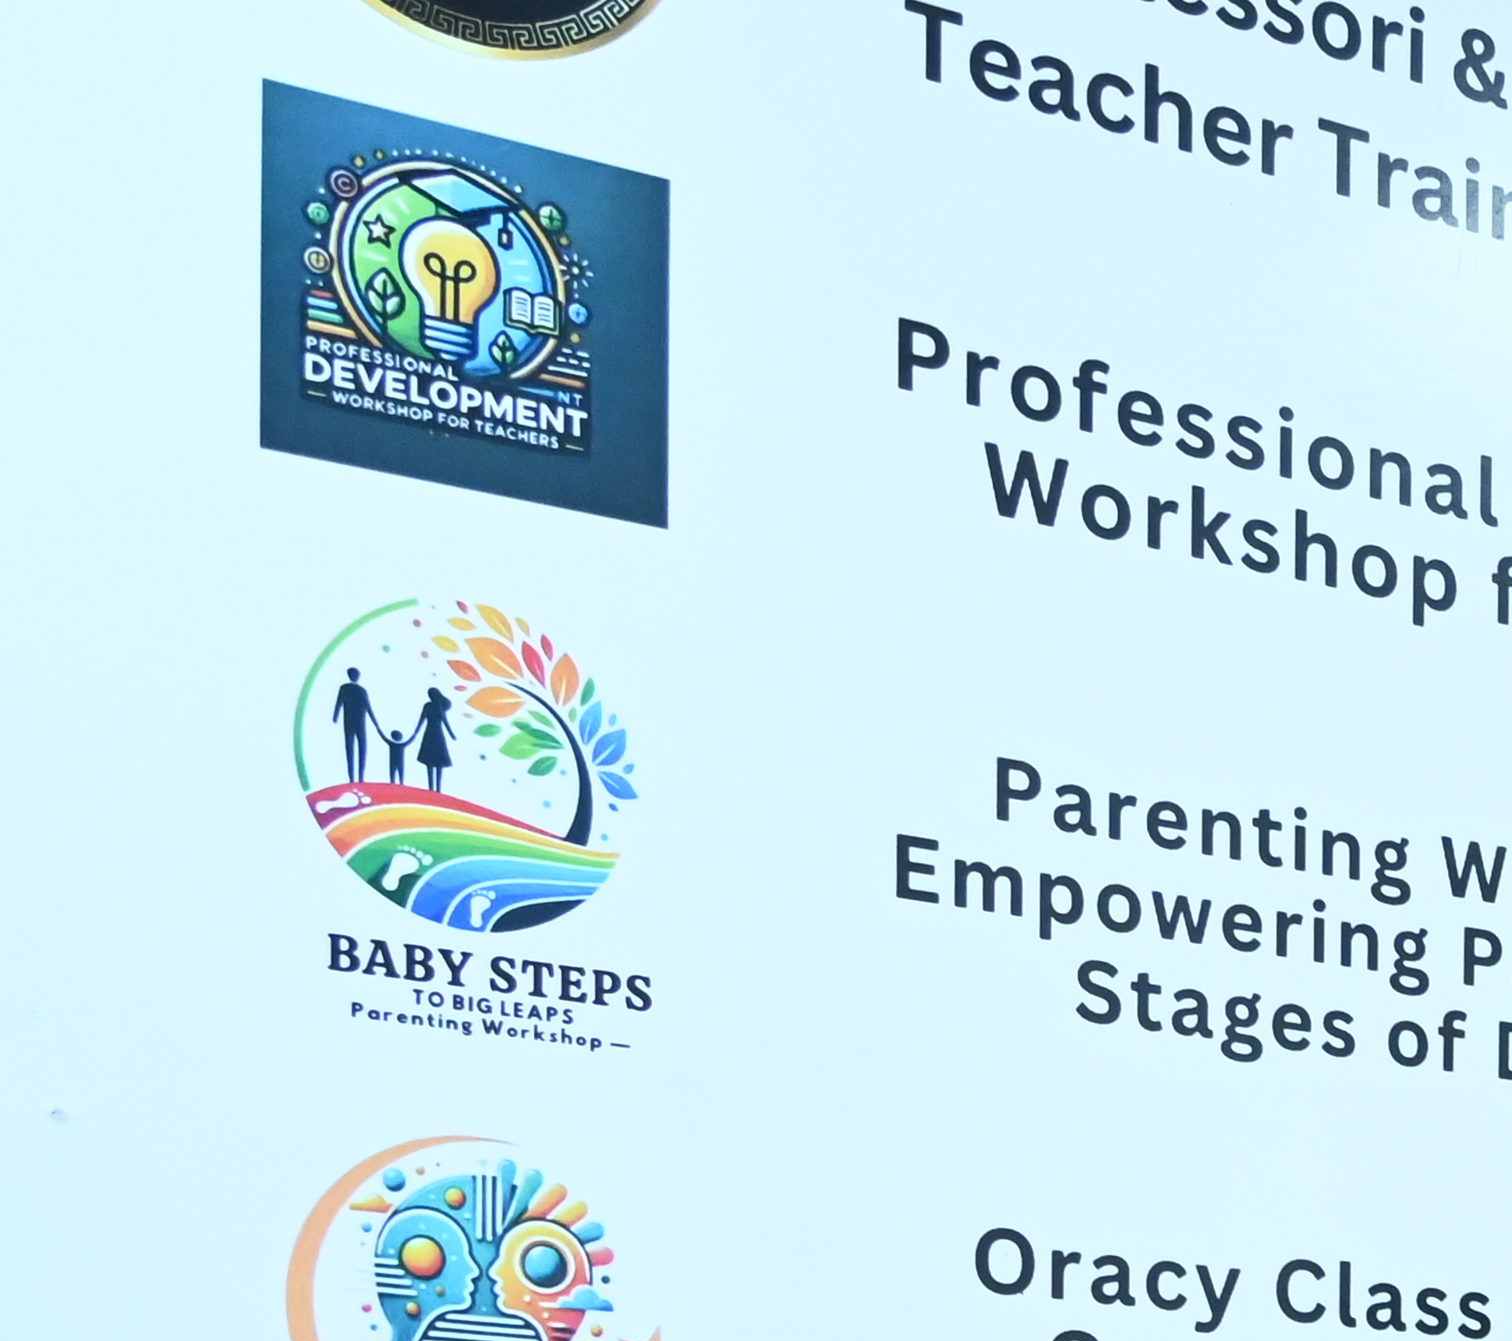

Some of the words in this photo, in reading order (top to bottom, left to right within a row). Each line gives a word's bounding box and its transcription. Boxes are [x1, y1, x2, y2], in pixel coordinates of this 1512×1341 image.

[903, 0, 1295, 177] Teacher
[1166, 0, 1426, 85] ssori
[1452, 27, 1509, 111] &
[304, 353, 588, 436] DEVELOPMENT
[305, 336, 458, 381] PROFESSIONAL
[333, 391, 433, 422] WORKSHOP
[438, 413, 469, 430] FOR
[475, 420, 559, 449] TEACHERS
[897, 316, 1500, 528] Professional
[983, 440, 1458, 628] Workshop
[995, 756, 1412, 907] Parenting
[895, 833, 1430, 997] Empowering
[328, 933, 474, 987] BABY
[490, 956, 653, 1012] STEPS
[351, 1002, 473, 1036] Parenting
[482, 1018, 602, 1052] Workshop
[412, 989, 444, 1008] TO
[453, 995, 493, 1014] BIG
[500, 1001, 574, 1025] LEAPS
[1074, 959, 1356, 1064] Stages
[1387, 1009, 1468, 1073] of
[974, 1226, 1242, 1334] Oracy
[1275, 1258, 1492, 1341] Class
